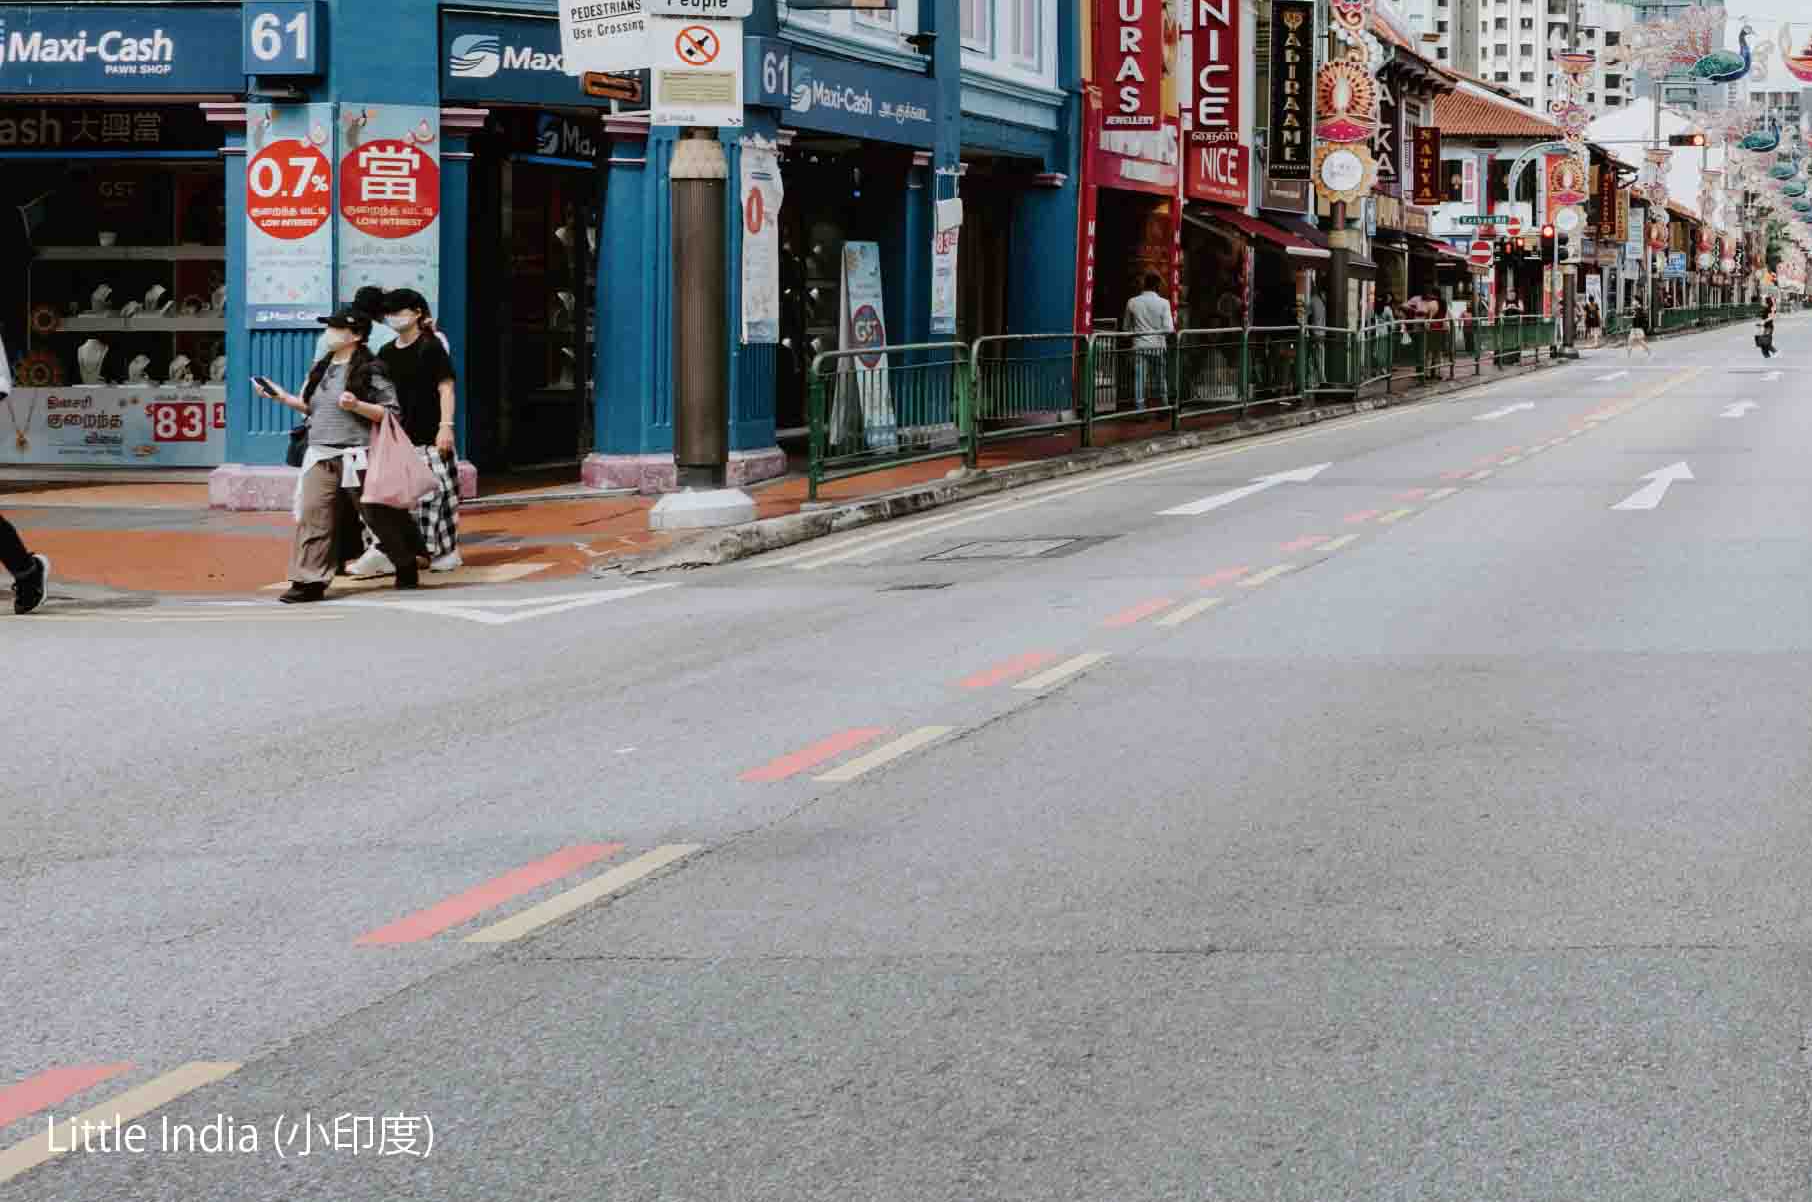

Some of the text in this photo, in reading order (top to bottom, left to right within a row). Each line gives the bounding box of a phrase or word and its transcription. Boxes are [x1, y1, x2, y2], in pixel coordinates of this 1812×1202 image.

[8, 29, 174, 62] Maxi-Cash
[250, 12, 309, 60] 61
[573, 19, 644, 40] Use Crossing
[105, 64, 171, 74] PAWN SHOP
[763, 52, 789, 95] 61
[812, 80, 873, 116] Maxi-Cash
[249, 157, 329, 198] 0.7%
[358, 145, 421, 203] 當
[1201, 147, 1239, 185] NICE
[1421, 130, 1432, 197] SATYA
